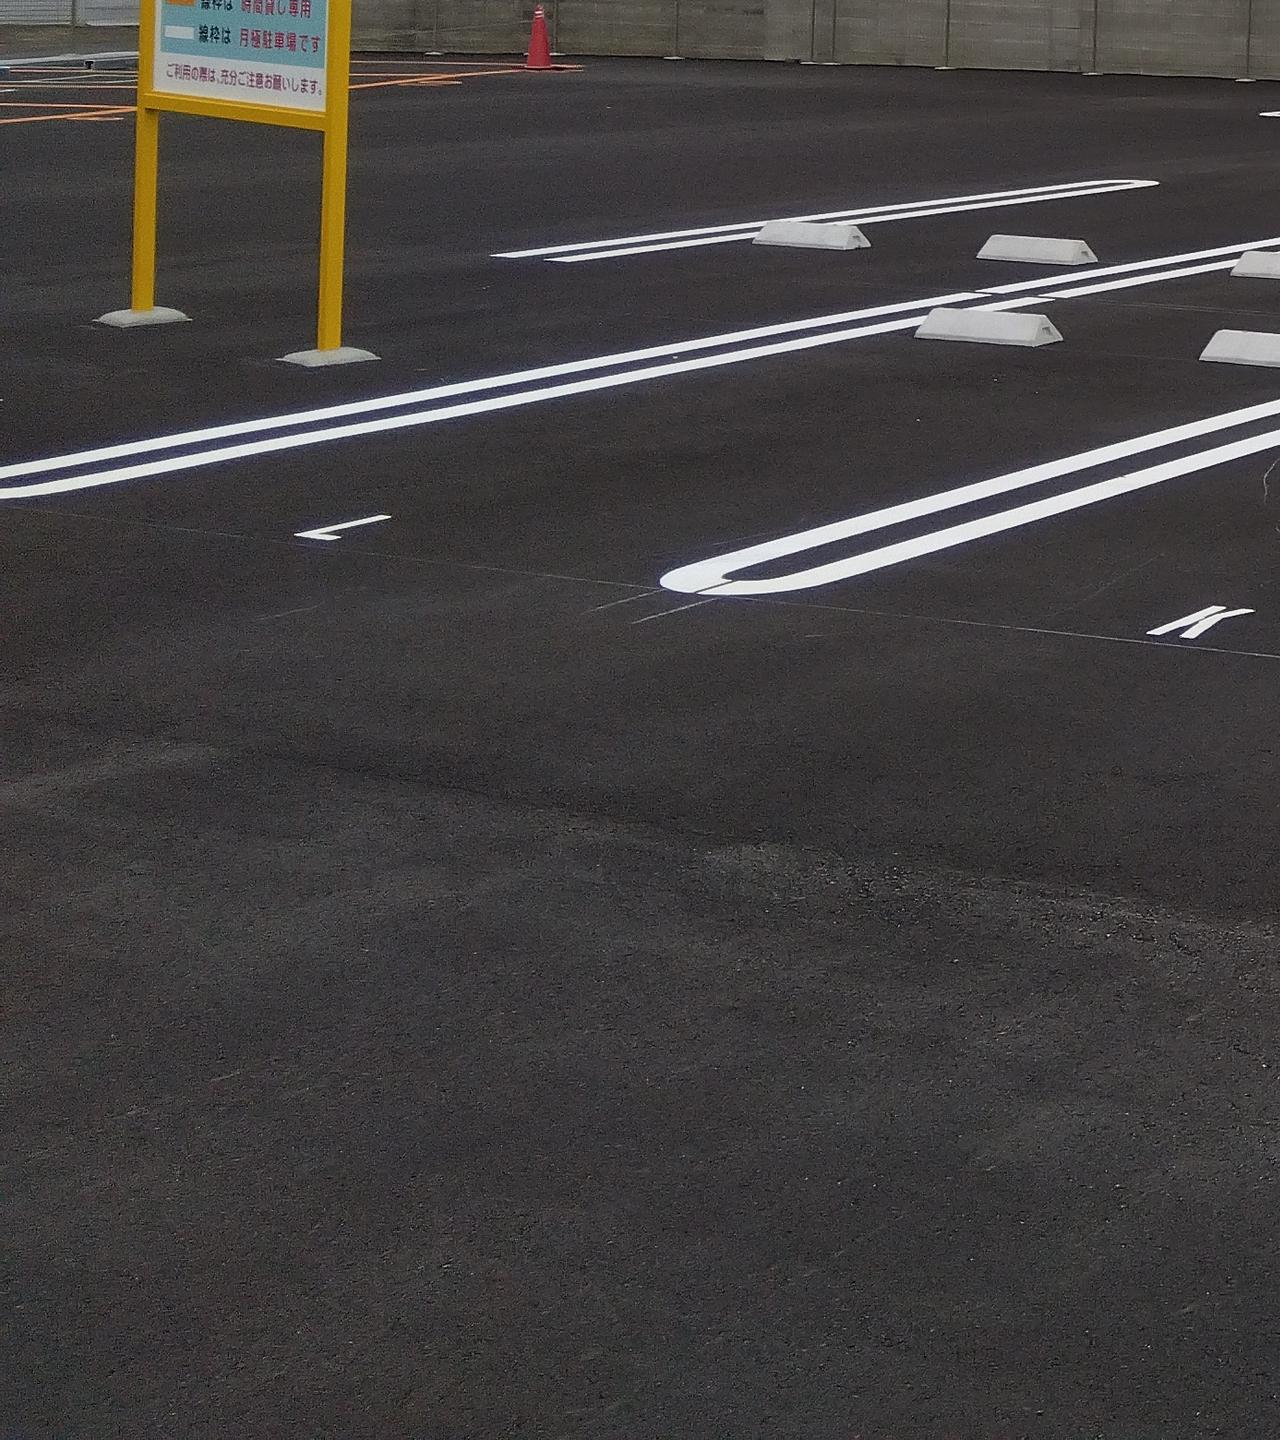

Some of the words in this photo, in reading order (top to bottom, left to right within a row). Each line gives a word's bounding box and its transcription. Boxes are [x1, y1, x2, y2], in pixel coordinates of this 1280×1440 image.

[198, 24, 231, 45] 線枠は
[239, 28, 321, 53] 月極駐車場です
[293, 514, 392, 541] L
[1146, 605, 1255, 639] K
